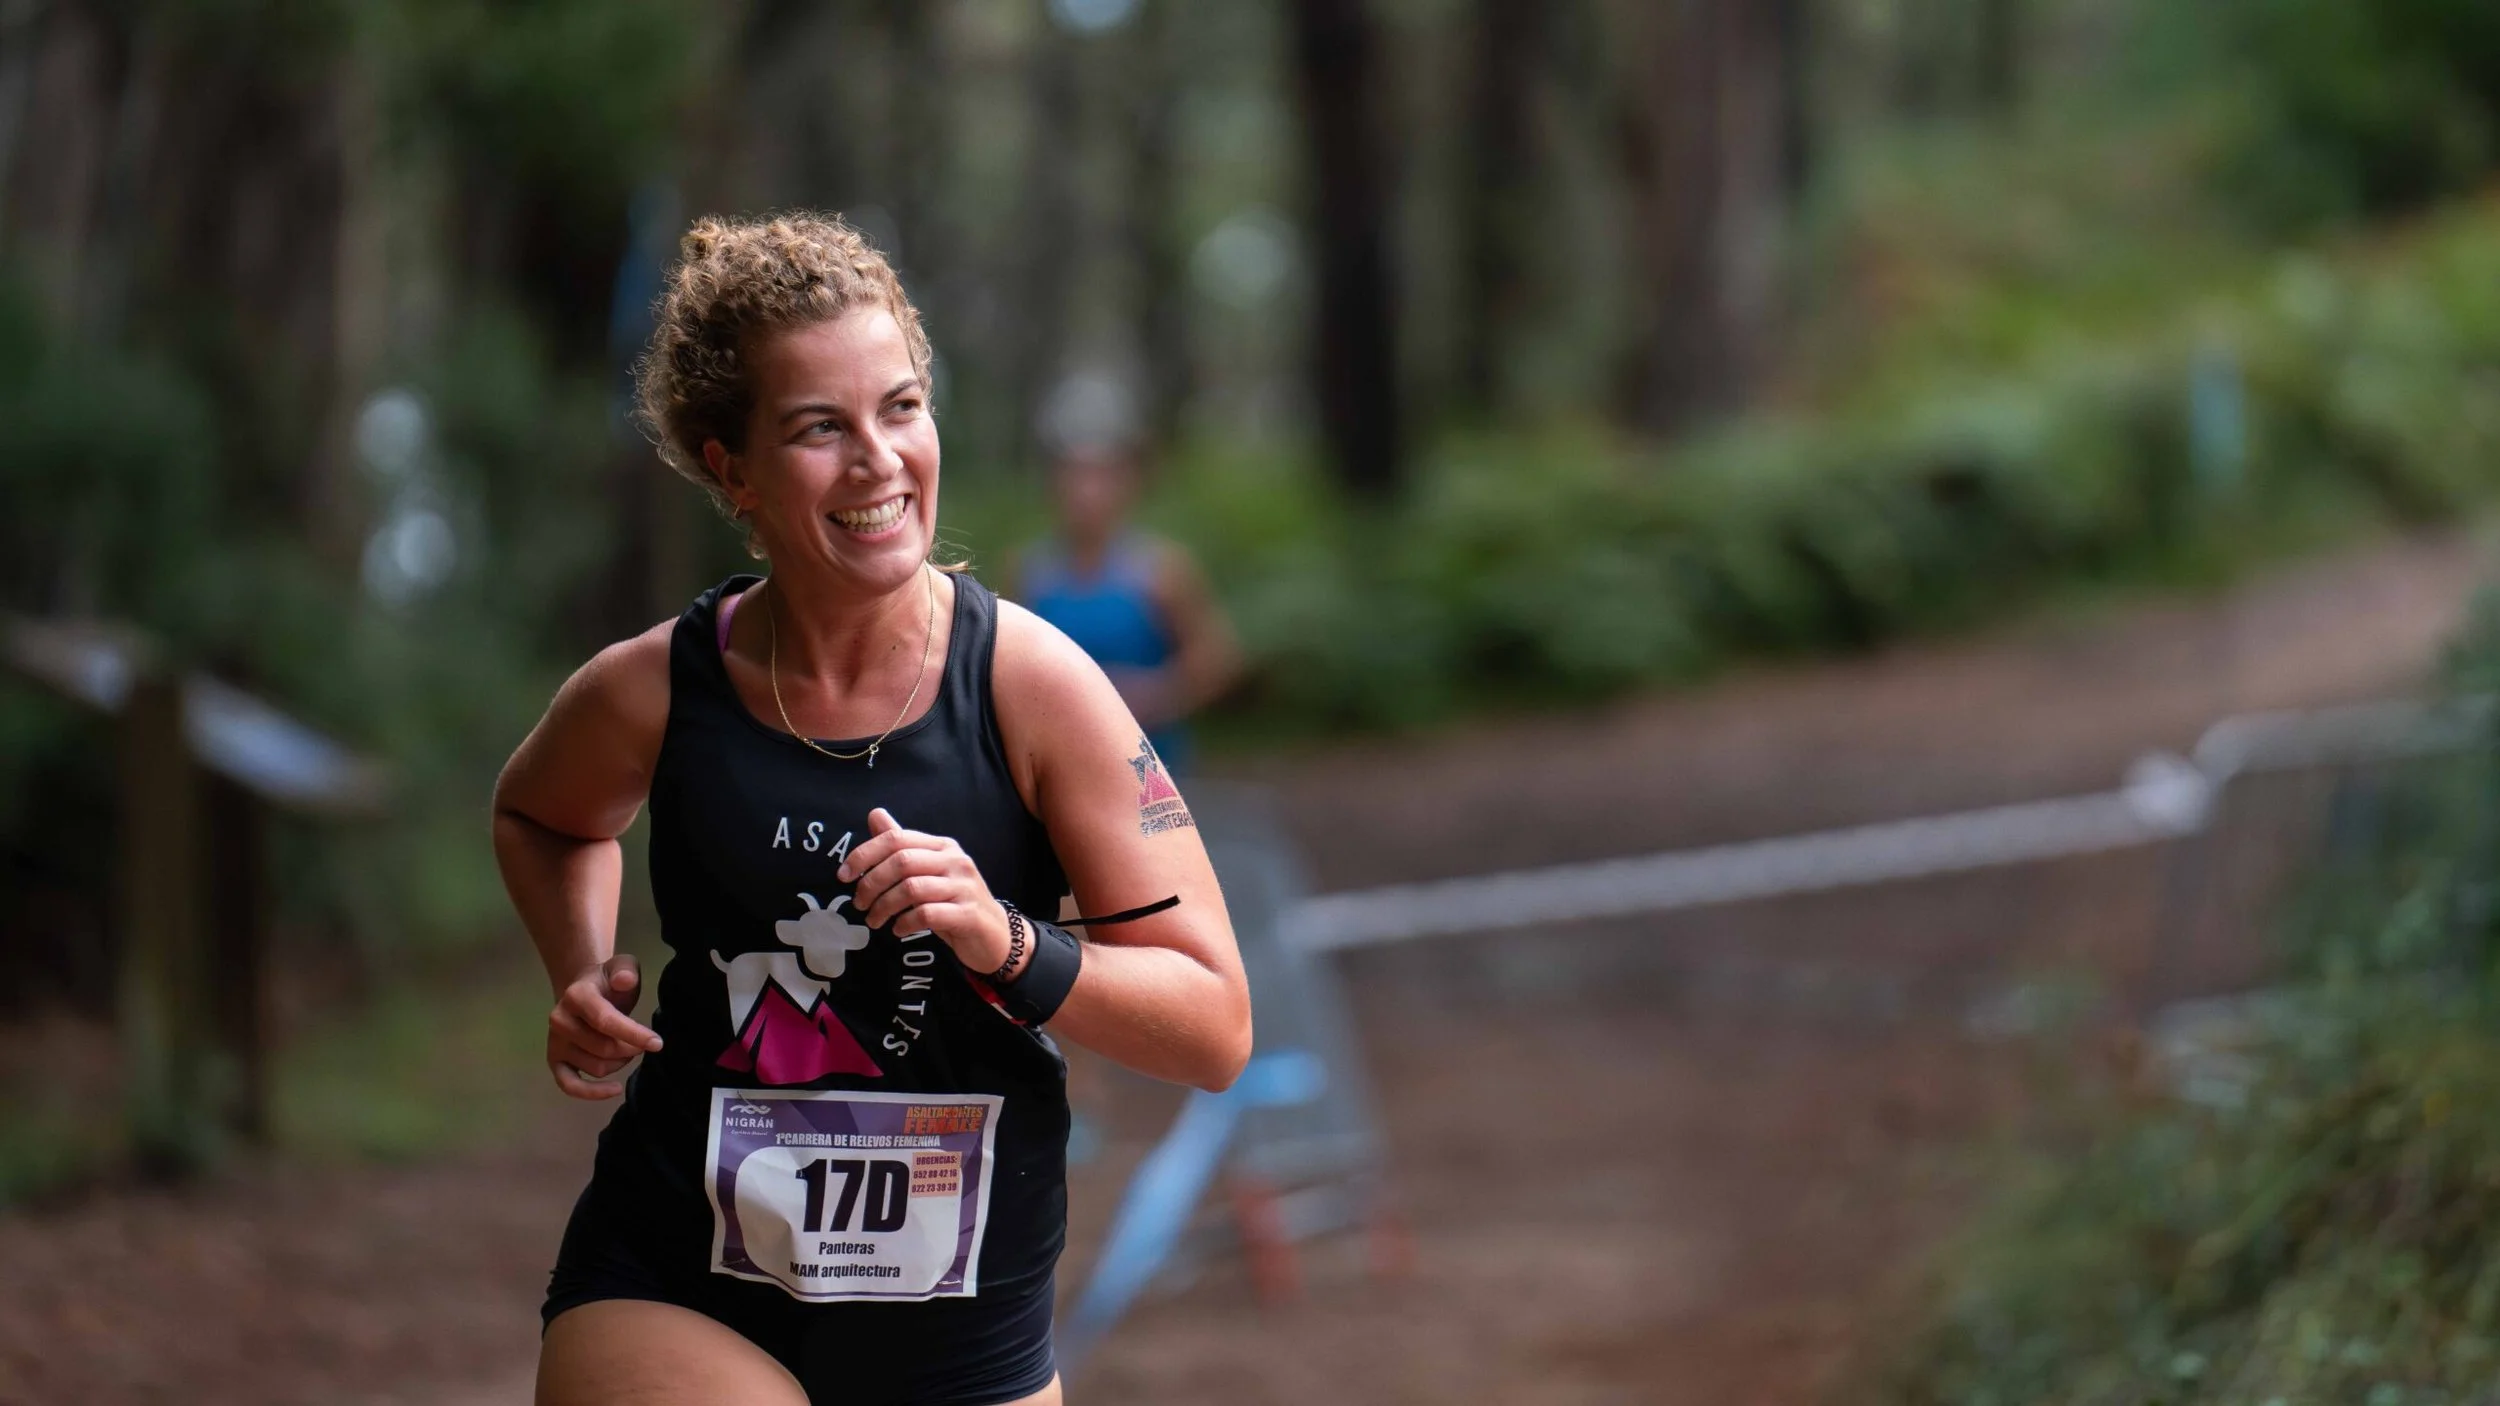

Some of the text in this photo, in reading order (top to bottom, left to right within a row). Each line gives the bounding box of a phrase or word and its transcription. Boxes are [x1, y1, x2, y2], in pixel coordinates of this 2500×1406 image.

[725, 1117, 774, 1129] NIGRÁN
[904, 1117, 982, 1134] FEMALE
[834, 1134, 848, 1146] DE
[850, 1135, 892, 1147] RELEVOS
[893, 1135, 941, 1147] FEMENINA
[795, 1158, 910, 1233] 17D
[818, 1241, 875, 1255] Panteras
[789, 1261, 901, 1278] MAM arquitectura
